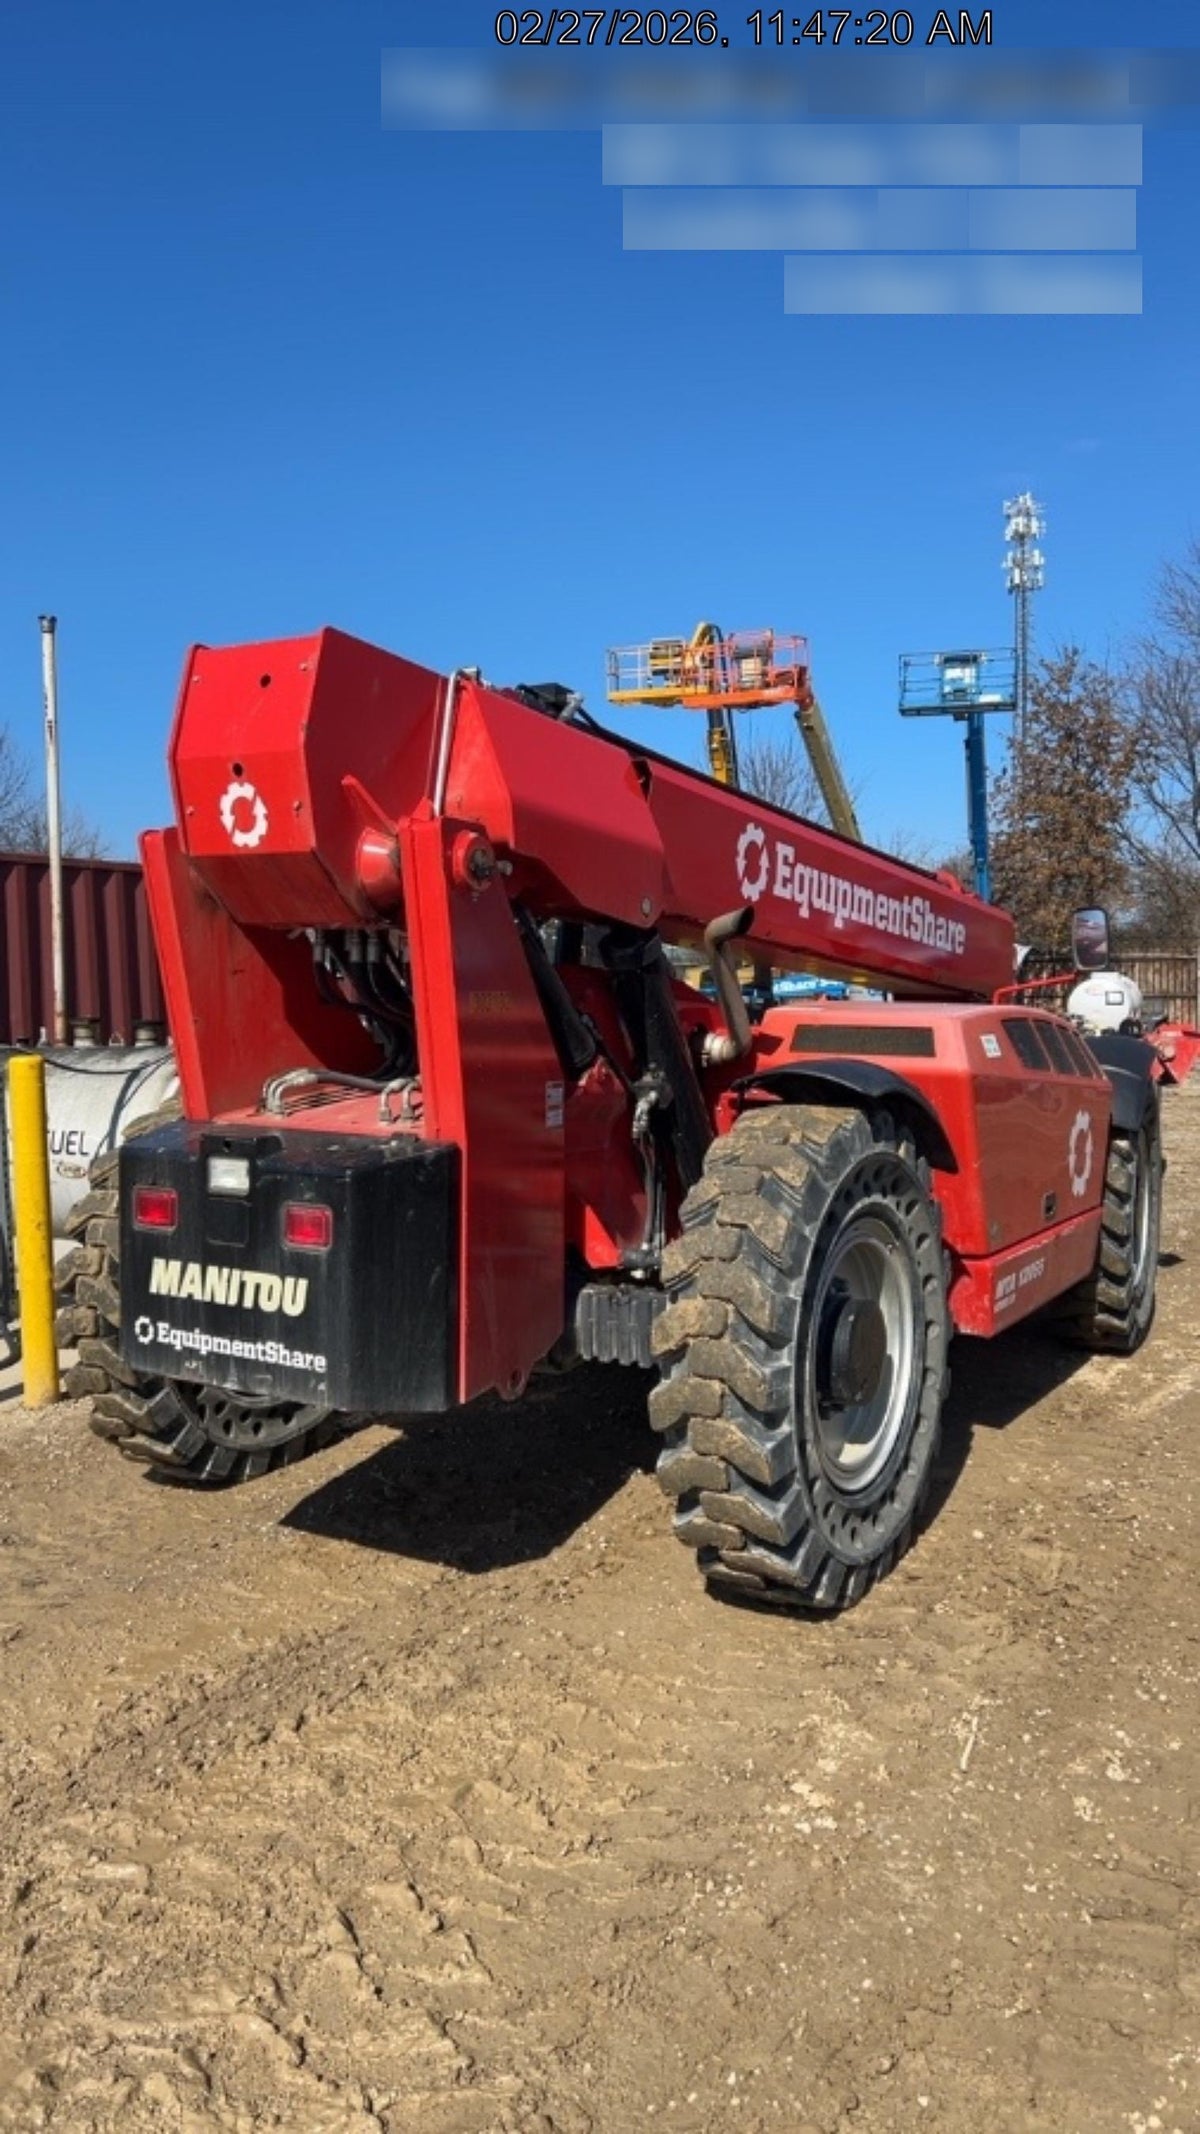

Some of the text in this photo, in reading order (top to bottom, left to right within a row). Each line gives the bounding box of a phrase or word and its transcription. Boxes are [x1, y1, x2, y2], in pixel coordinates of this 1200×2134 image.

[773, 841, 967, 954] EquipmentShare
[47, 1130, 89, 1156] UEL
[149, 1257, 309, 1317] MANITOU
[156, 1322, 327, 1374] EquipmentShare
